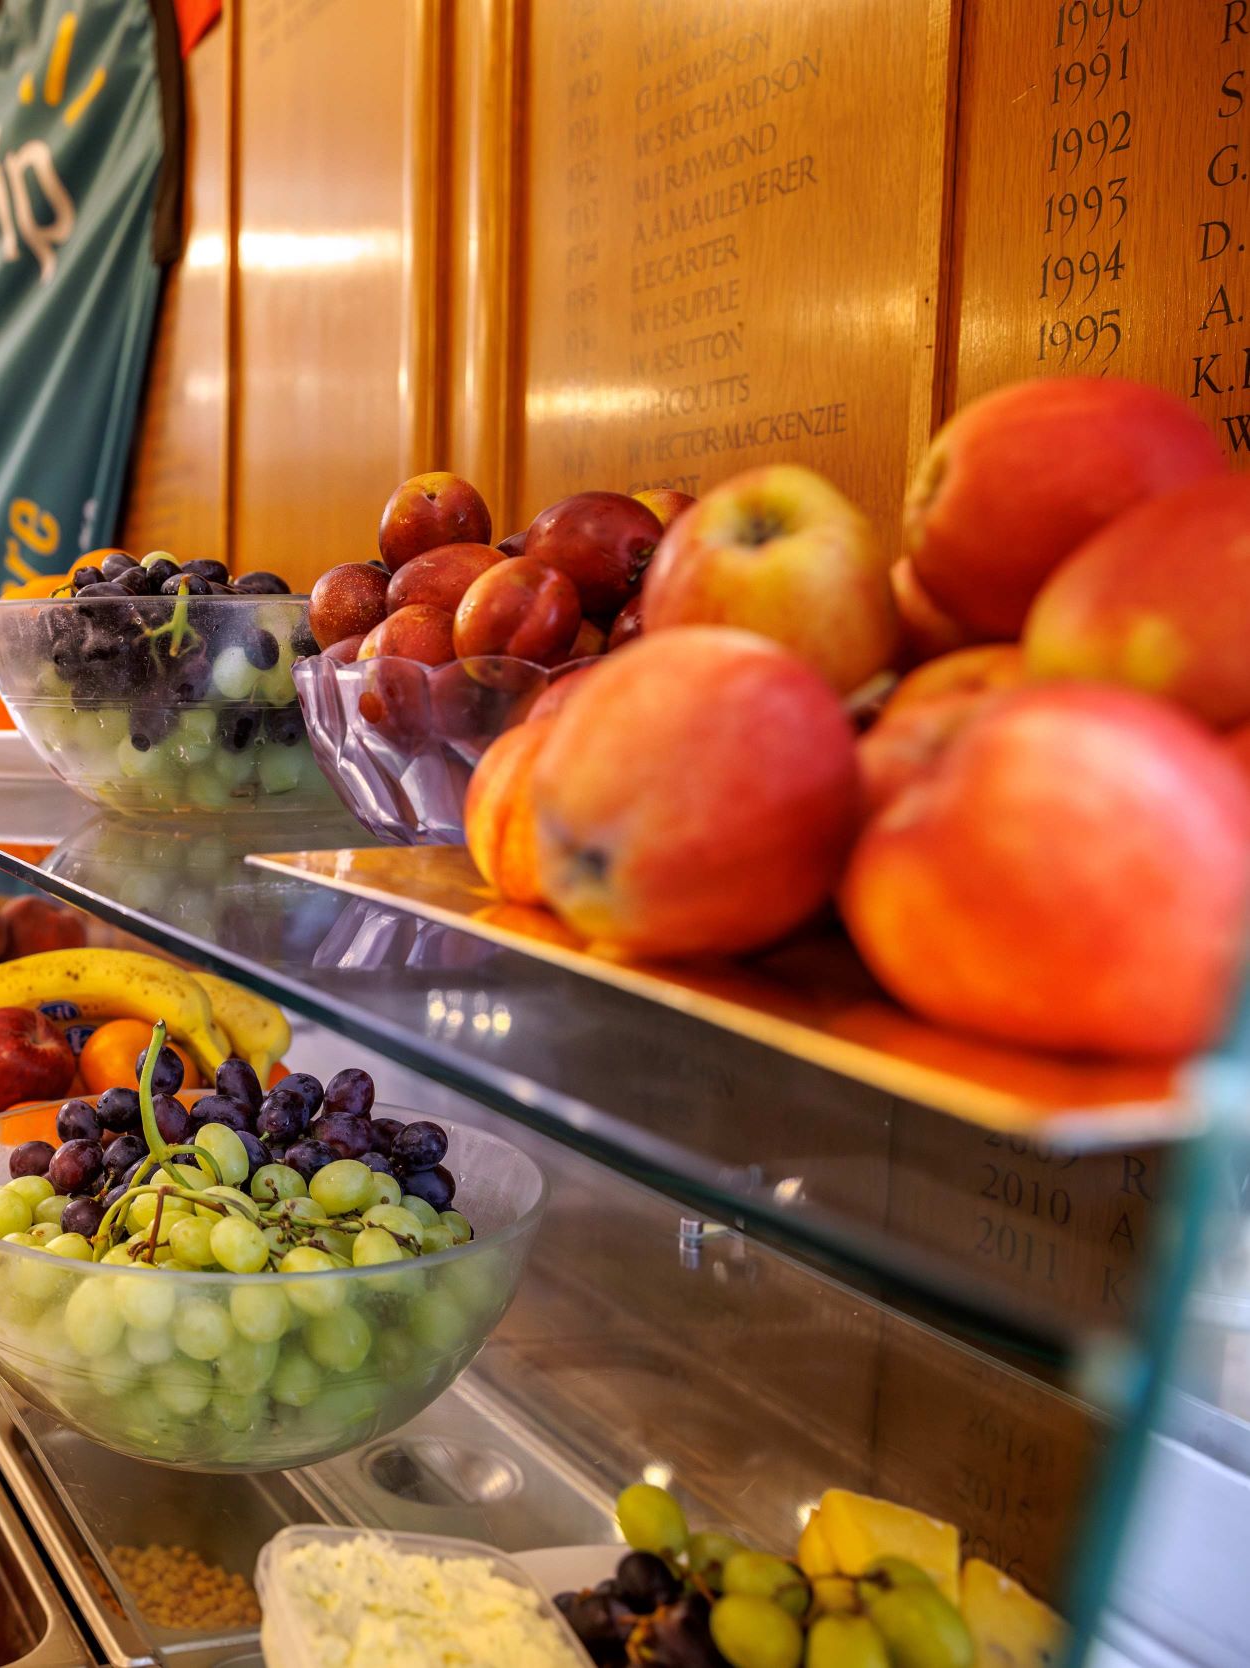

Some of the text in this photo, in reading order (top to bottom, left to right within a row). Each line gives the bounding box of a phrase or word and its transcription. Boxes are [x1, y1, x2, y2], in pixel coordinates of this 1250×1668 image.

[1051, 38, 1129, 107] 1991
[1048, 110, 1131, 177] 1992
[1044, 177, 1127, 239] 1993
[1039, 239, 1125, 309] 1994
[1037, 309, 1121, 367] 1995
[980, 1163, 1071, 1225] 2010
[977, 1216, 1055, 1281] 2011
